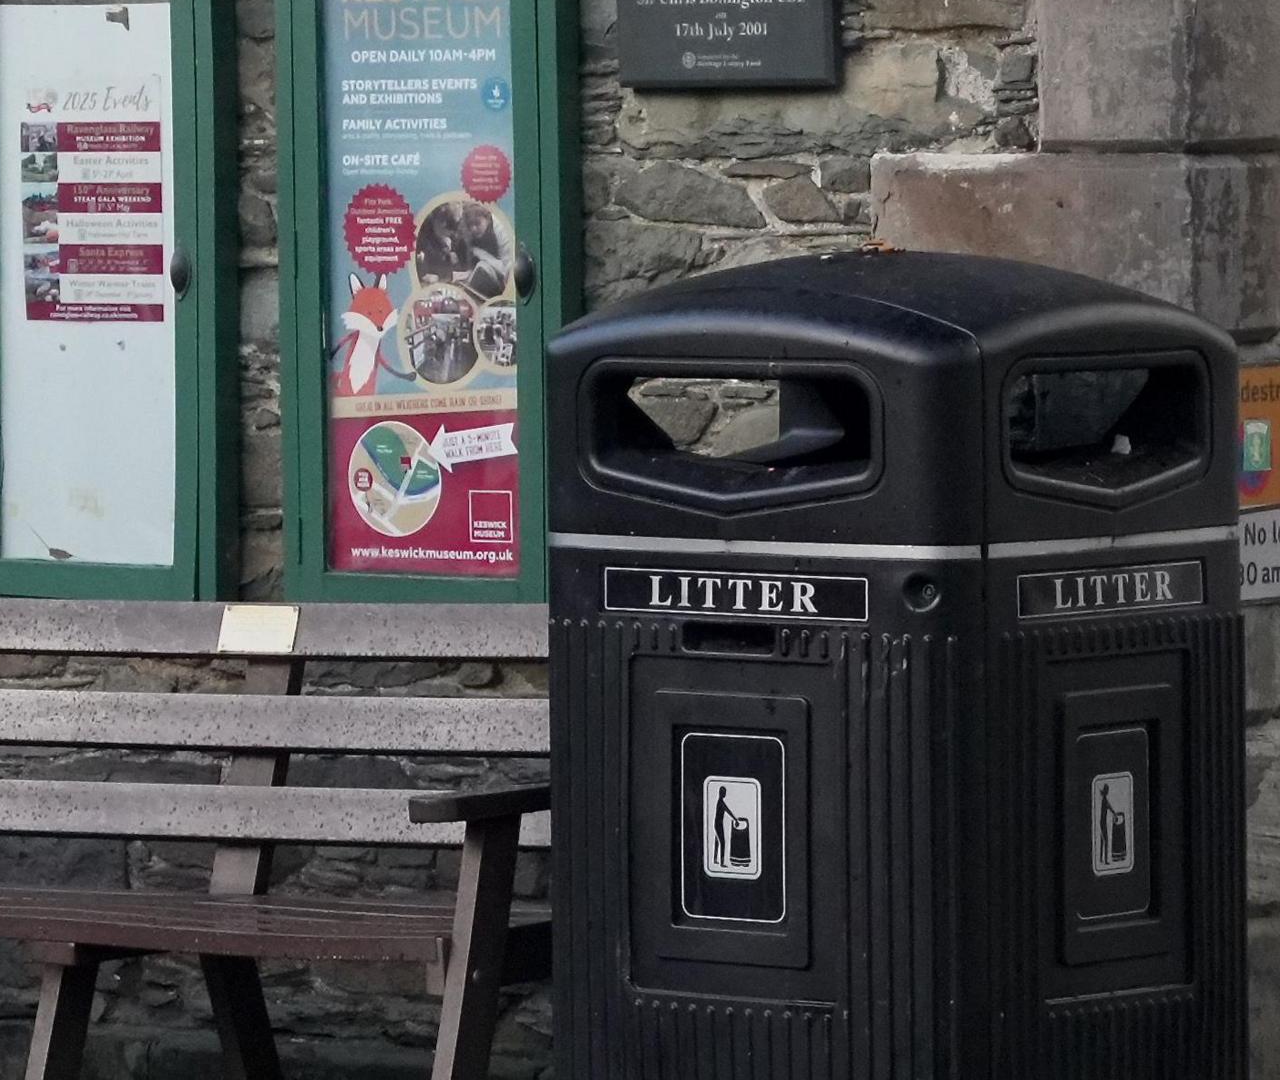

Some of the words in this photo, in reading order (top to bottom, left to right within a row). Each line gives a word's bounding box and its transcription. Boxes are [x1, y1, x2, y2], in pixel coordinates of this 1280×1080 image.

[343, 6, 502, 40] MUSEUM
[675, 23, 703, 37] 17th
[707, 22, 735, 41] July
[740, 22, 767, 36] 2001
[351, 50, 387, 63] OPEN
[390, 49, 425, 63] DAILY
[429, 48, 496, 62] 10AM-4PM
[341, 80, 429, 91] STORYTELLERS
[432, 79, 478, 90] EVENTS
[62, 92, 98, 111] 2025
[103, 84, 153, 112] Events
[342, 93, 367, 105] AND
[370, 92, 442, 105] EXHIBITIONS
[342, 119, 382, 130] FAMILY
[384, 118, 447, 129] ACTIVITIES
[342, 154, 388, 166] ON-SITE
[391, 152, 420, 165] CAFÉ
[465, 445, 483, 456] FROM
[473, 521, 507, 529] KESWICK
[473, 530, 505, 538] MUSEUM
[1244, 522, 1266, 546] No
[351, 546, 513, 563] www.keswickmuseum.org.uk
[648, 573, 819, 614] LITTER
[1053, 569, 1175, 612] LITTER
